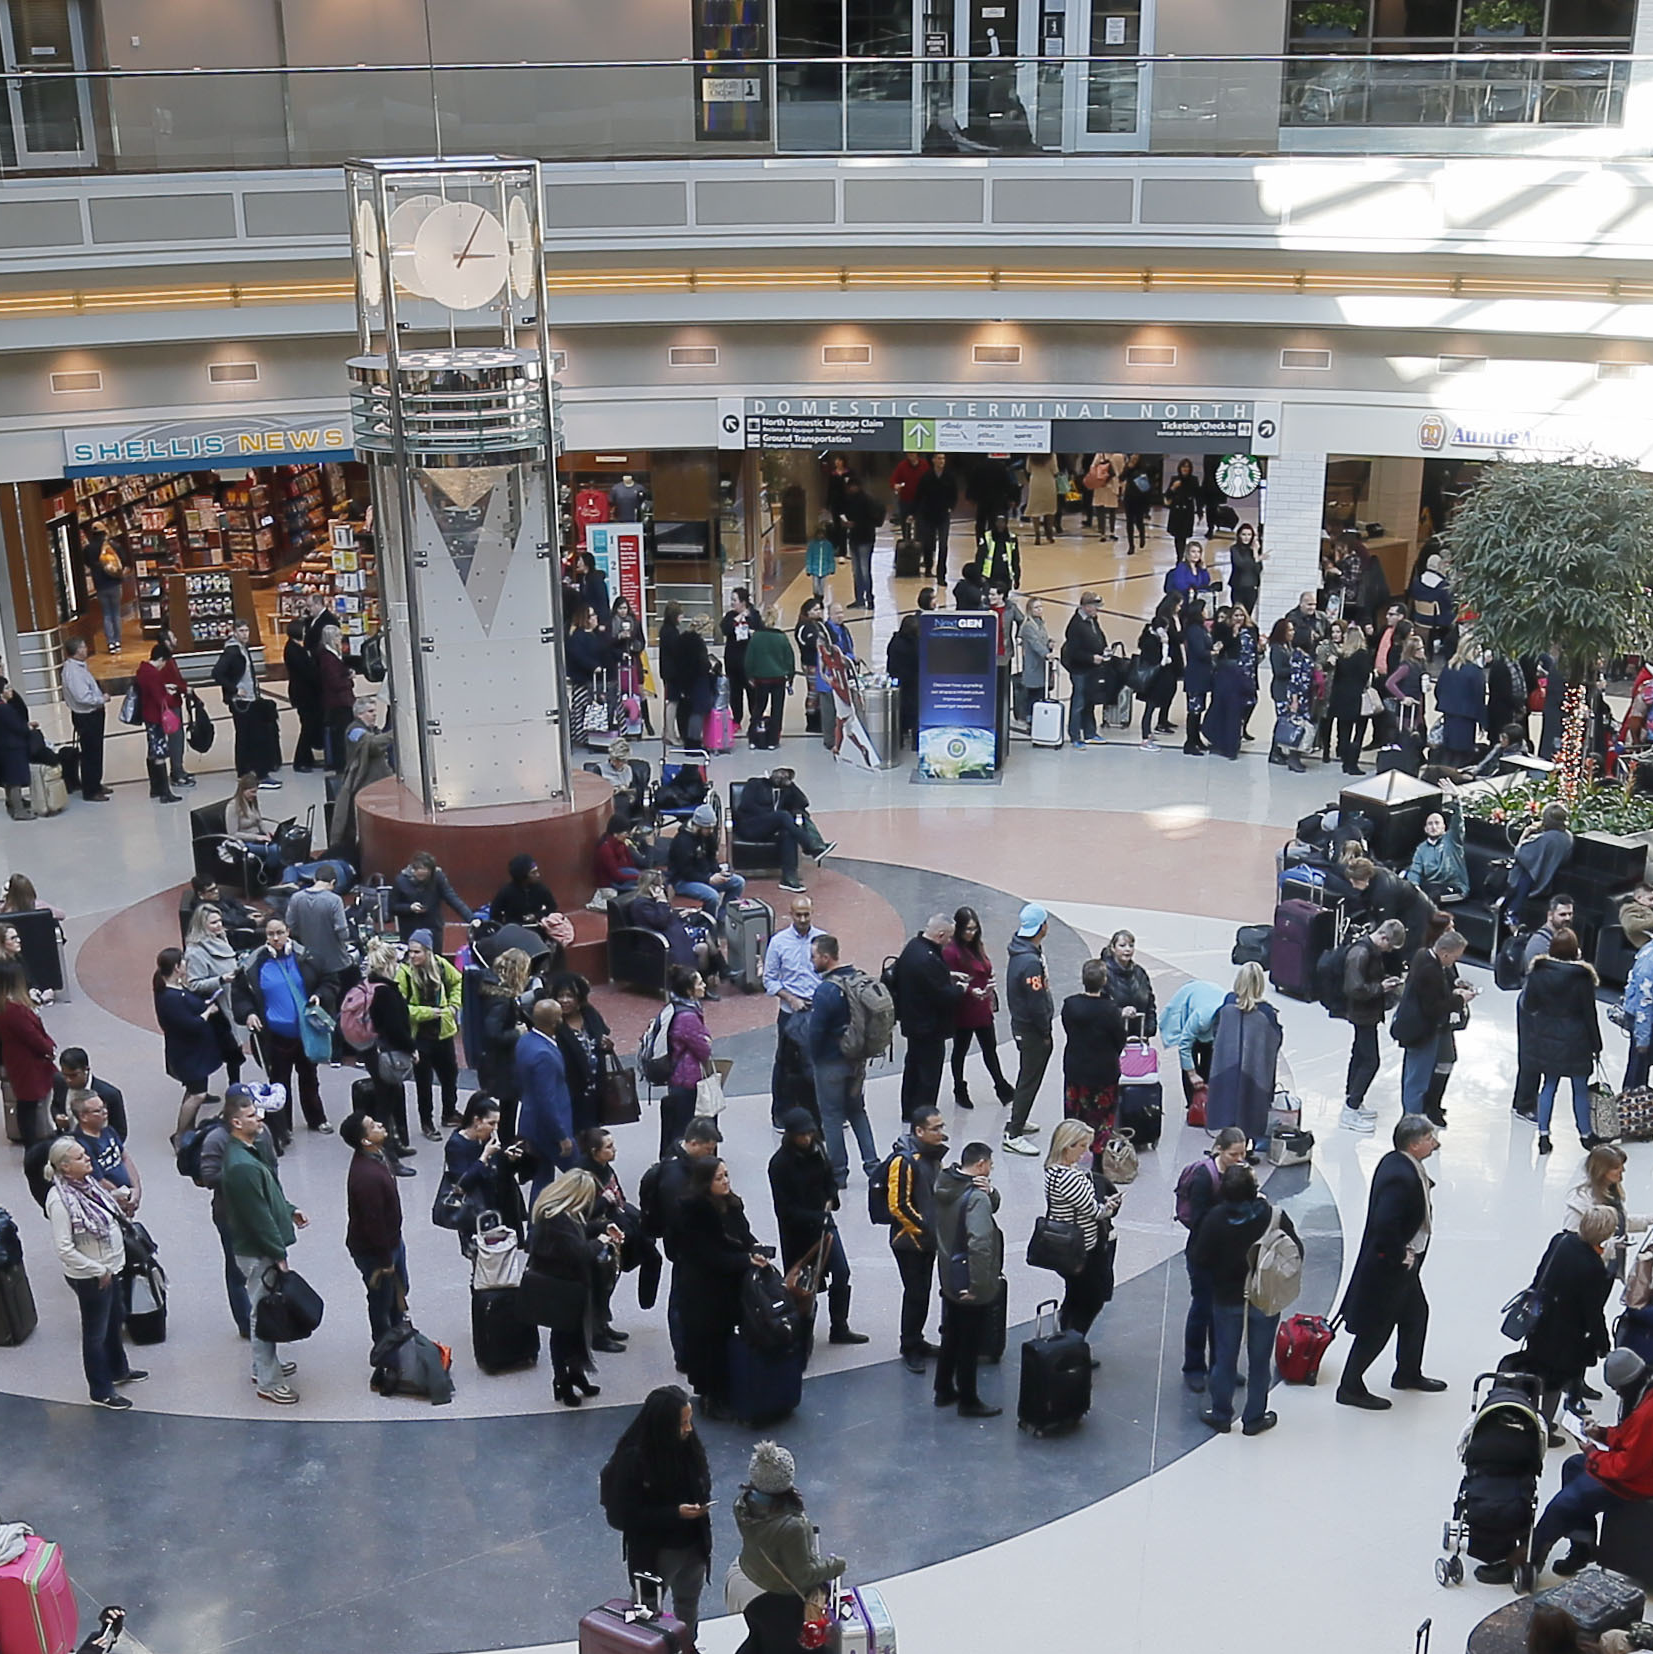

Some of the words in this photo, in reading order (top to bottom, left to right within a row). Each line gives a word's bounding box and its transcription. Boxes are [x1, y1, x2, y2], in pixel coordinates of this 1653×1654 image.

[754, 400, 919, 416] DOMESTIC
[946, 402, 1112, 418] TERMINAL
[1140, 404, 1246, 419] NORTH
[762, 418, 785, 427] North
[786, 418, 823, 427] Domestic
[825, 419, 859, 429] Baggage
[861, 420, 884, 428] Claim
[74, 435, 225, 462] SHELLIS
[239, 429, 345, 453] NEWS
[762, 434, 793, 442] Ground
[794, 435, 852, 444] Transportation
